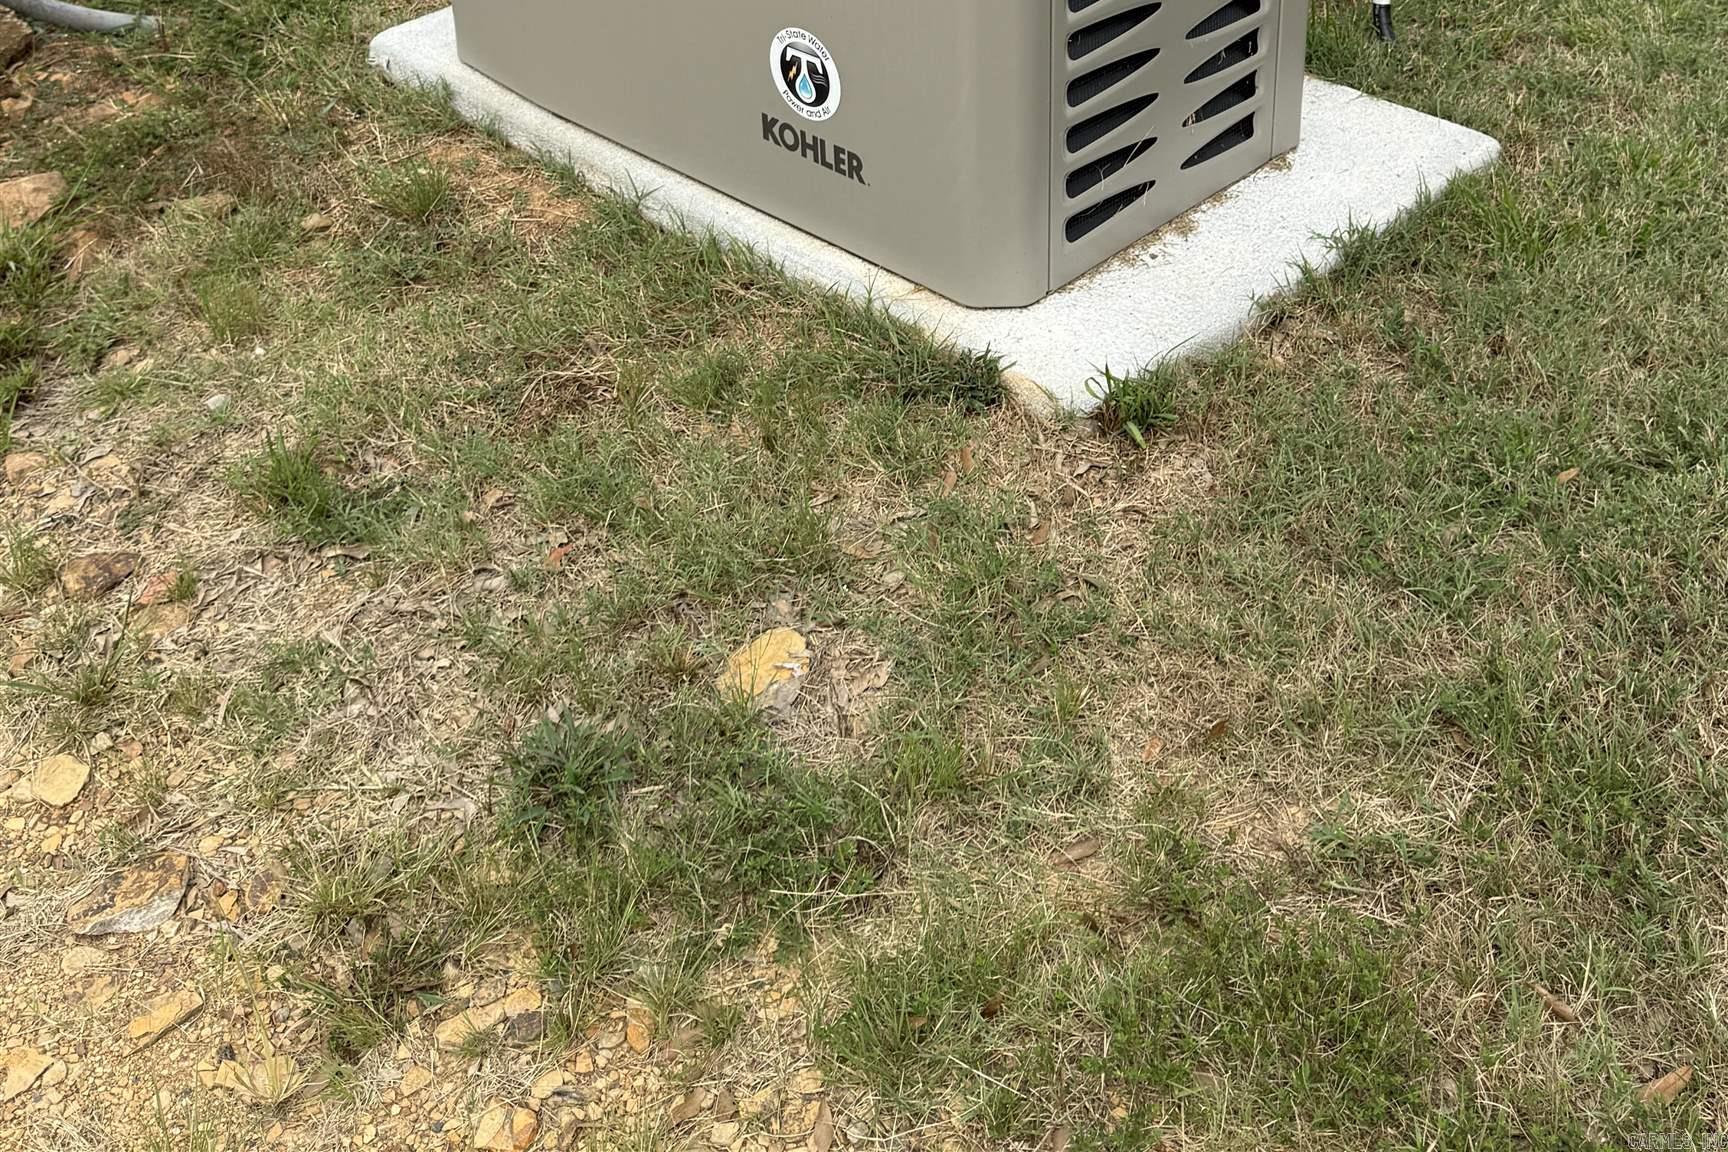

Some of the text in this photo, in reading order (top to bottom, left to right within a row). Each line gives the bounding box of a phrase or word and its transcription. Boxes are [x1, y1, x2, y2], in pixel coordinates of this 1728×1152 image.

[777, 30, 830, 61] Tri-State Water
[782, 90, 831, 119] Power and Air
[761, 112, 867, 186] KOHLER
